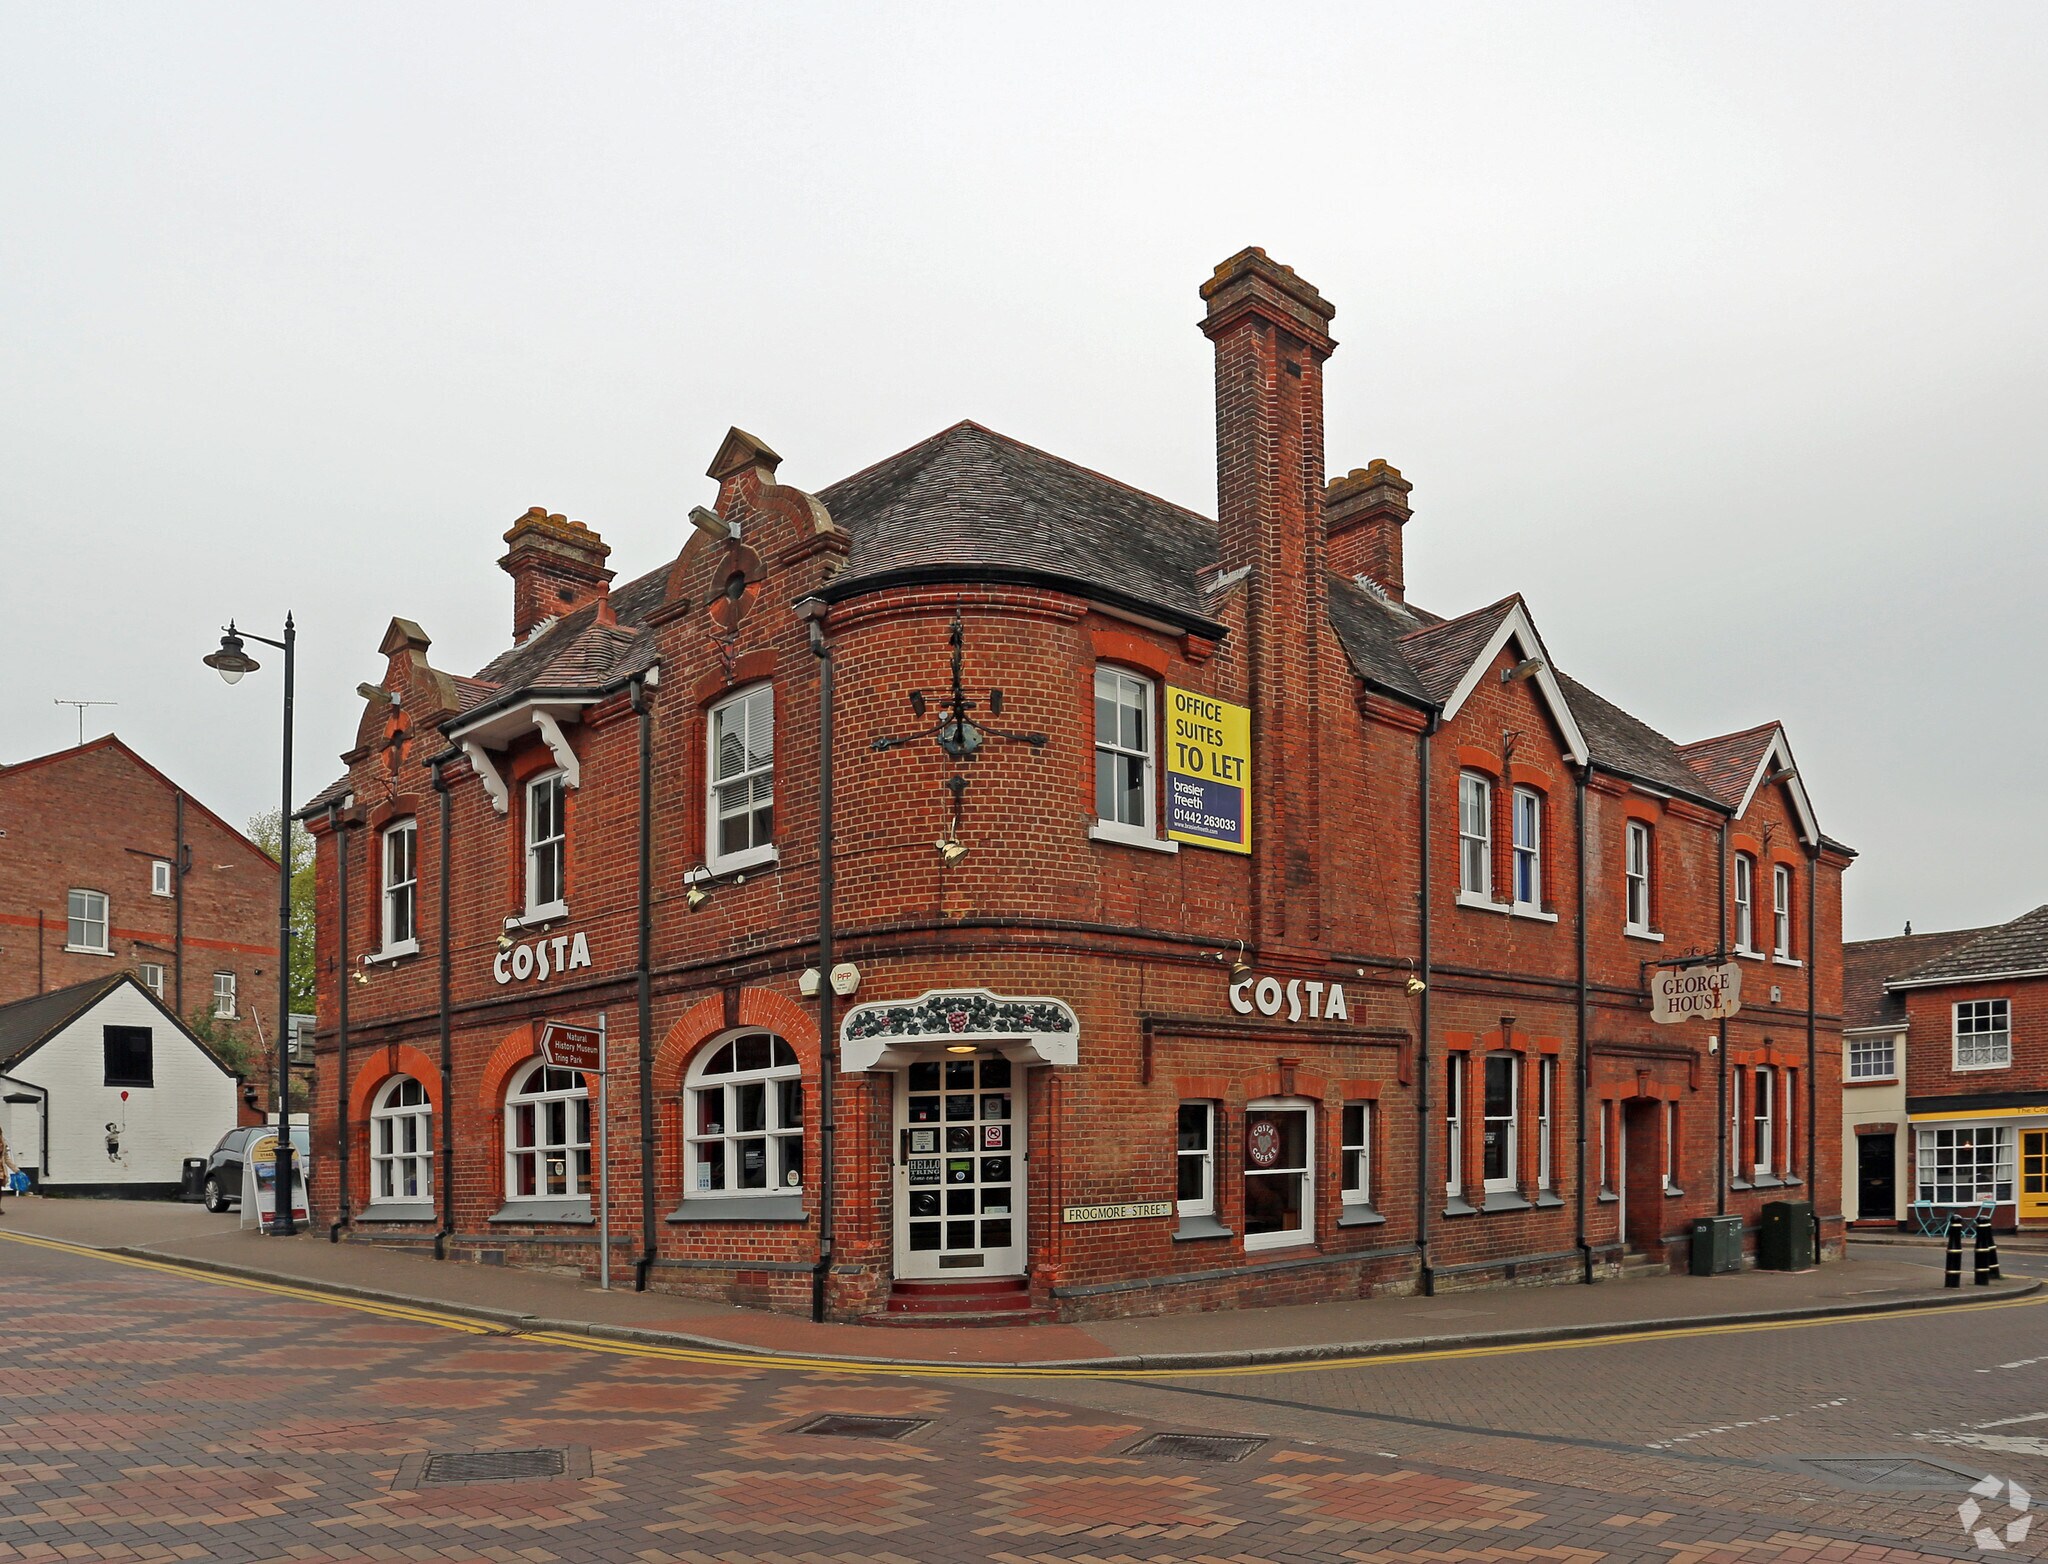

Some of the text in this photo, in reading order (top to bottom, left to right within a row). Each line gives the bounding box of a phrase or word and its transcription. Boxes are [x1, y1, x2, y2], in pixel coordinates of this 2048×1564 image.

[1175, 693, 1222, 723] OFFICE
[1175, 718, 1223, 747] SUITES
[1176, 742, 1244, 782] TO LET
[1173, 777, 1204, 797] brasier
[1174, 792, 1203, 810] freeth
[1174, 808, 1236, 831] 01442 263033
[493, 931, 592, 985] COSTA
[1662, 973, 1730, 996] GEORGE
[1229, 976, 1348, 1023] COSTA
[1667, 992, 1723, 1014] HOUSE
[554, 1040, 598, 1054] History Museum
[566, 1032, 588, 1043] Natural
[554, 1053, 583, 1065] Tring Park
[1253, 1124, 1274, 1137] COSTA
[1252, 1147, 1277, 1162] COFFEE
[910, 1160, 940, 1170] HELLO
[1069, 1203, 1168, 1220] FROGMORE STREET
